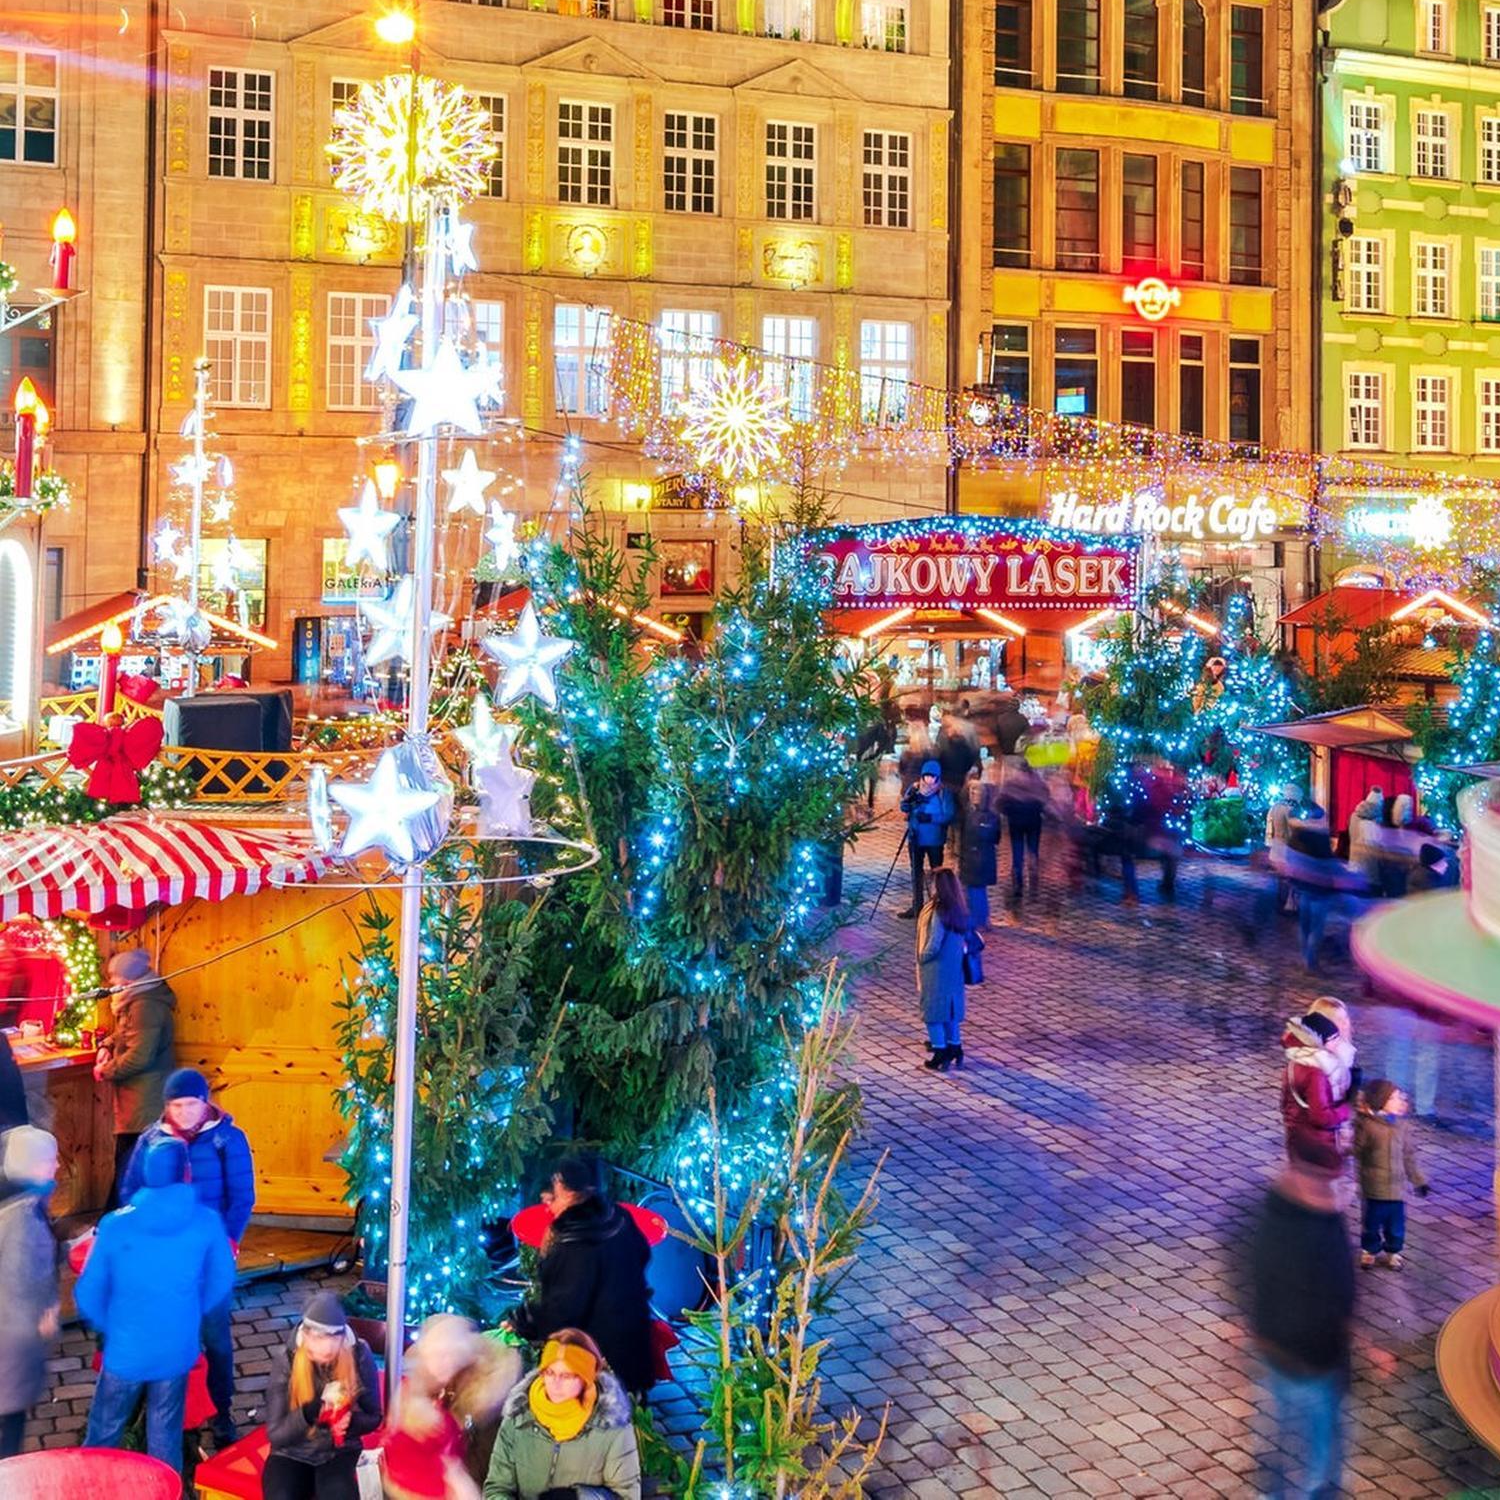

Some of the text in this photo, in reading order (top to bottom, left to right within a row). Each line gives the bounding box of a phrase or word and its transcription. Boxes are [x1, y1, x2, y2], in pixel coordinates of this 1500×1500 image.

[1049, 491, 1277, 541] Hard Rock Cafe
[1006, 554, 1126, 596] LASEK
